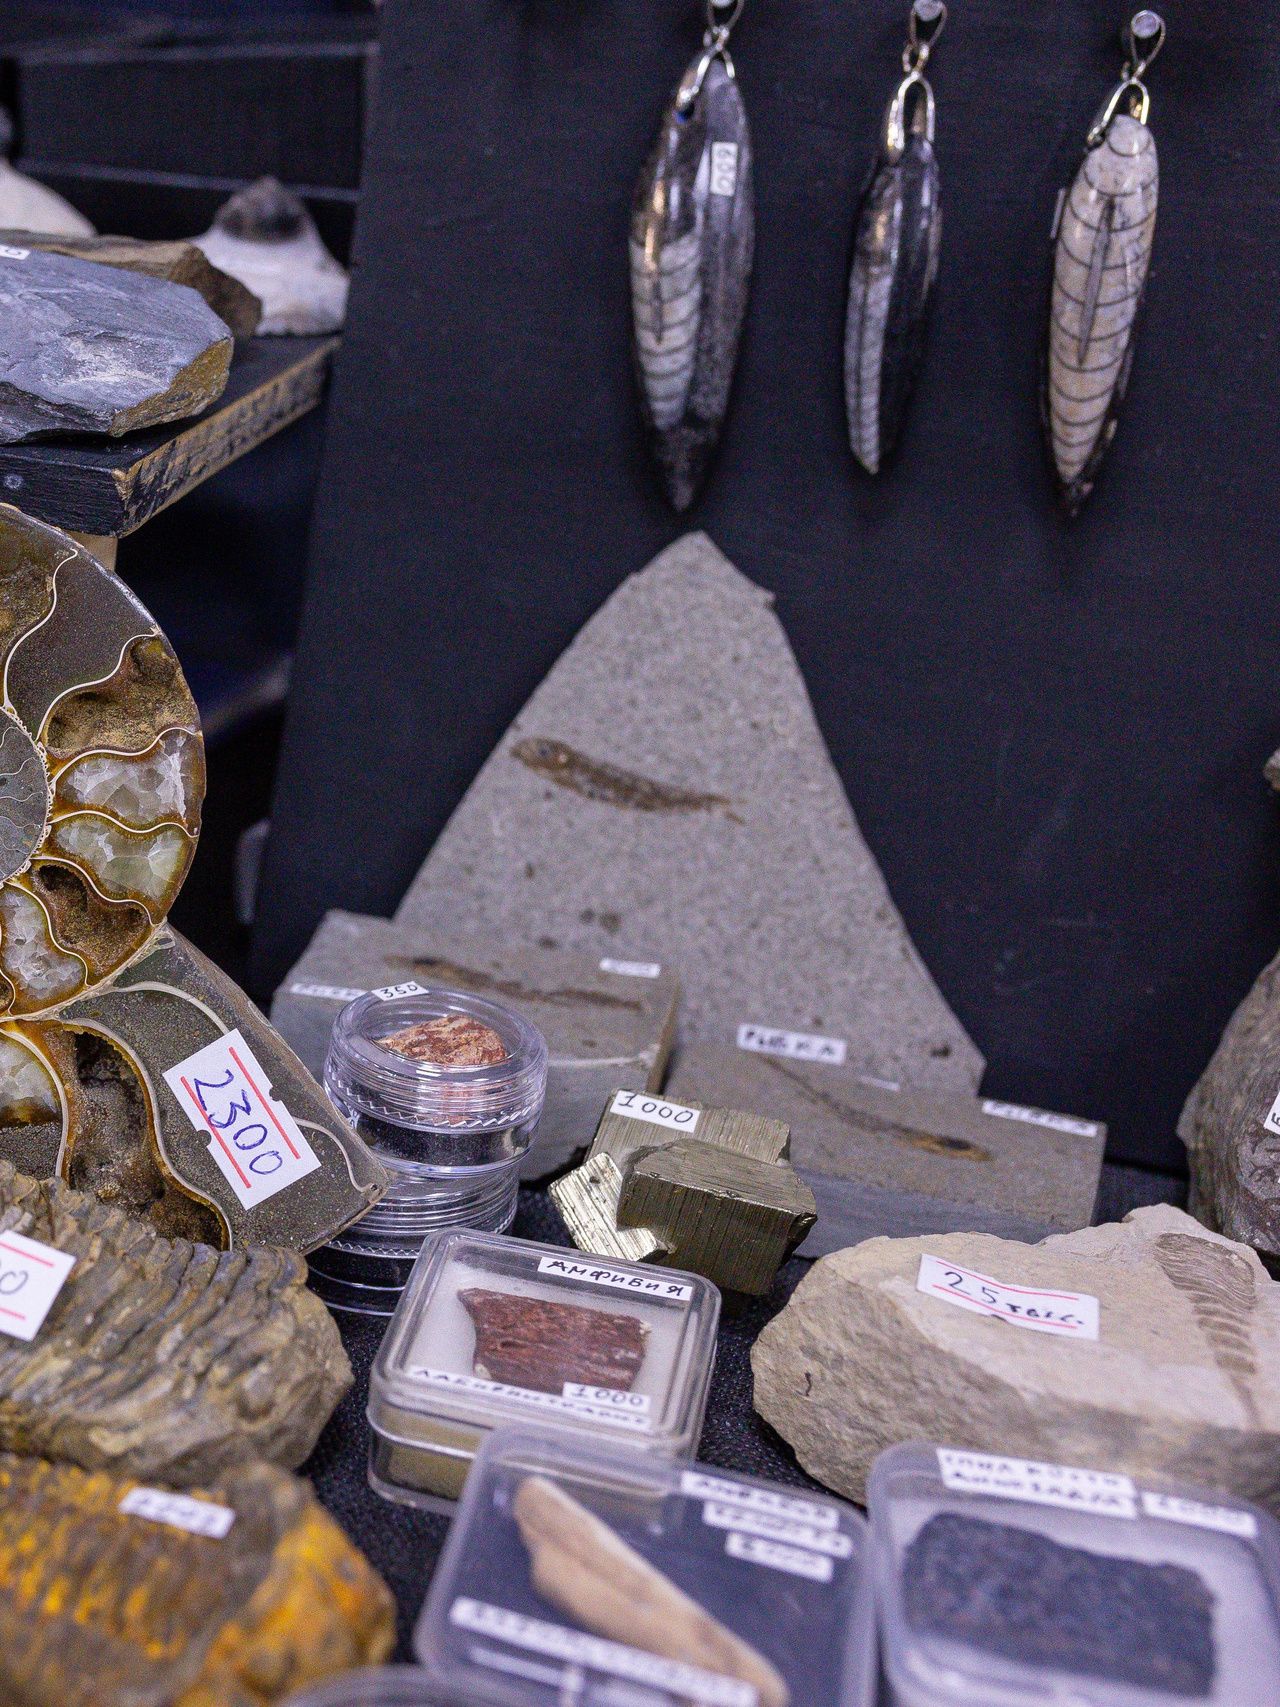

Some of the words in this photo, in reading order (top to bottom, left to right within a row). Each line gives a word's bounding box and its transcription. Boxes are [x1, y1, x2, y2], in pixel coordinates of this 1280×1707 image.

[380, 983, 419, 998] 350
[193, 1068, 283, 1176] 2300
[618, 1093, 694, 1123] 1000
[547, 1261, 684, 1296] АМФИБИЯ
[944, 1271, 1001, 1304] 25
[572, 1385, 643, 1407] 1000
